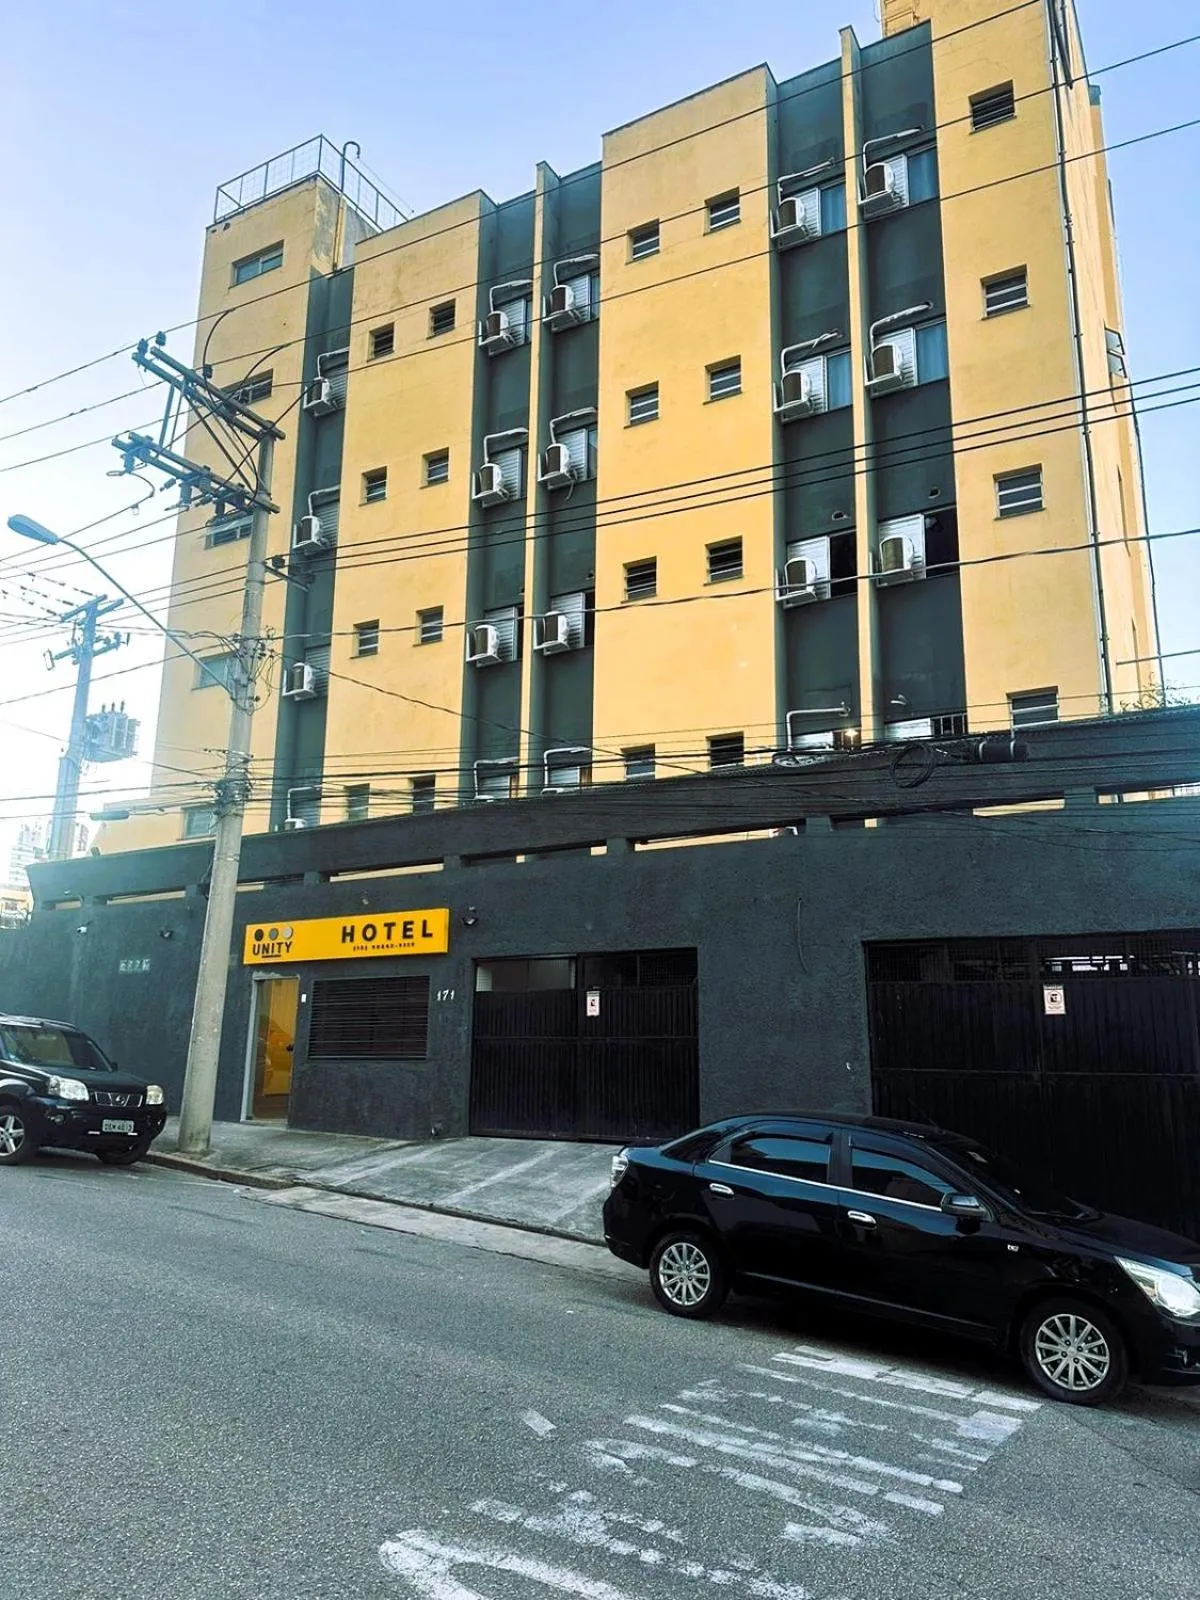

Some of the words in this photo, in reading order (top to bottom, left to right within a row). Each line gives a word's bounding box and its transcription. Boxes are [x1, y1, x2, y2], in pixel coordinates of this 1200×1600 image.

[341, 919, 433, 943] HOTEL
[252, 941, 292, 956] UNITY
[437, 989, 455, 1001] 171
